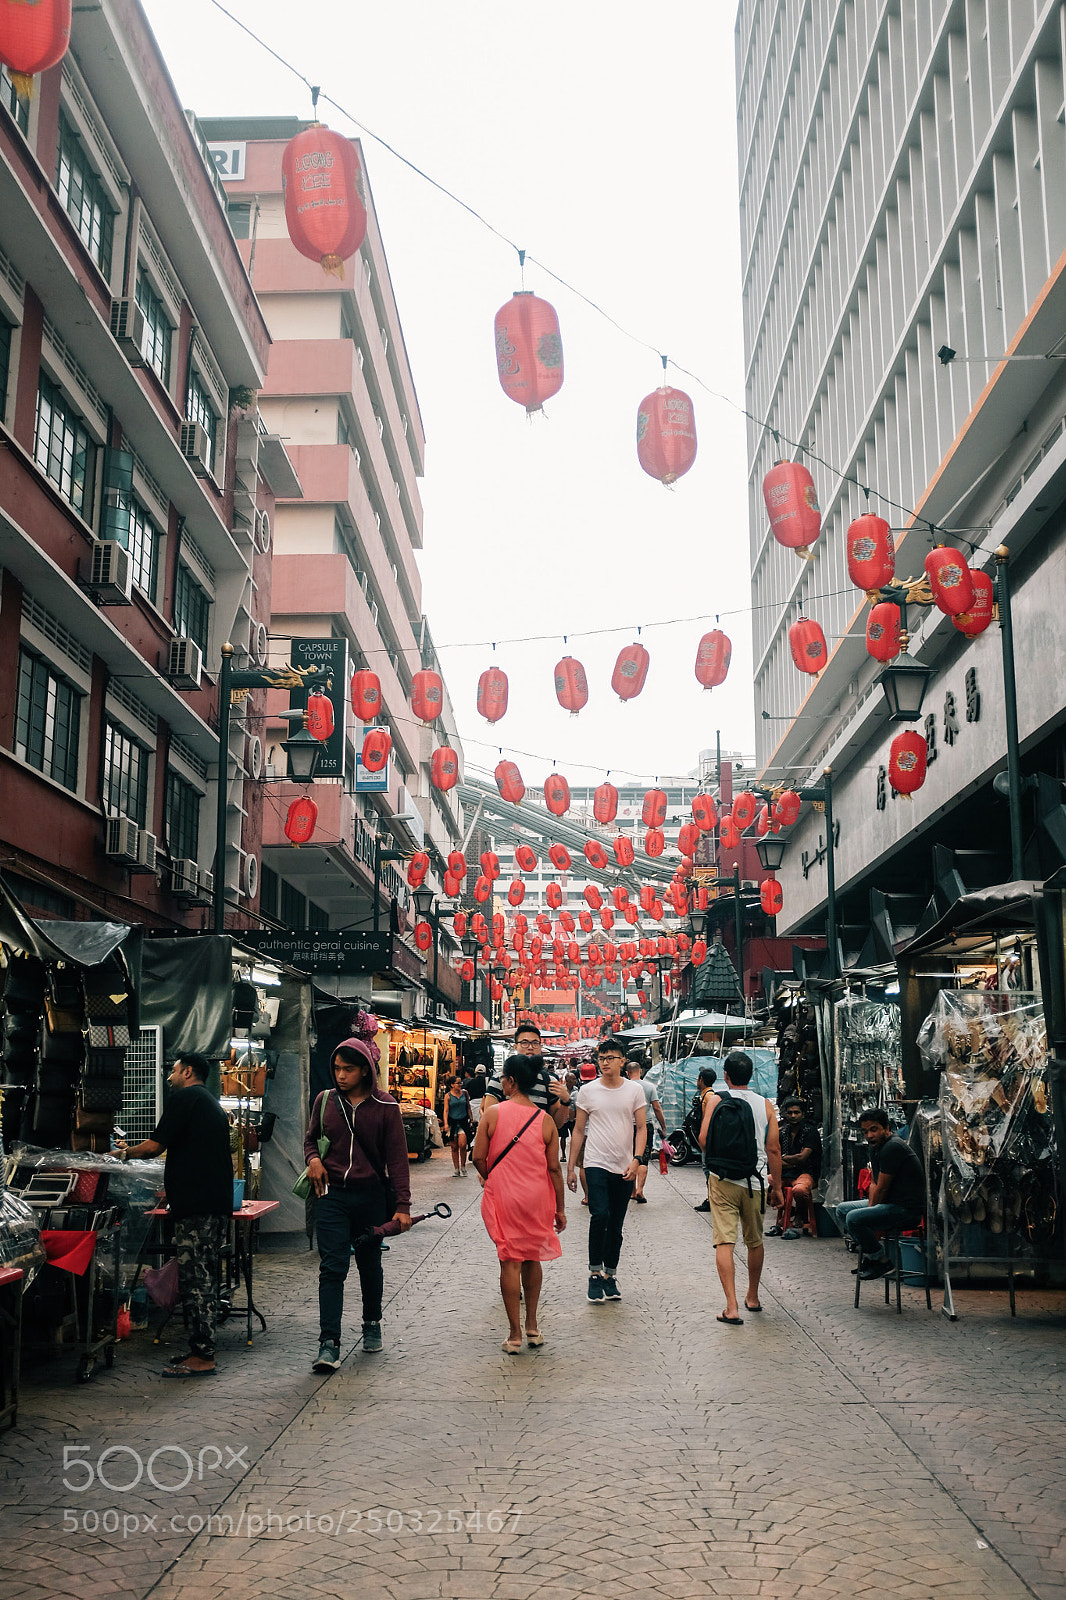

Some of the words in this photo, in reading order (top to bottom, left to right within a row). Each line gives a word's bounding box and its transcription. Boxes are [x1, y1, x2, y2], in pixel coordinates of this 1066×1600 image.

[294, 151, 335, 173] LOONG
[301, 172, 332, 191] KEE
[298, 643, 339, 652] CAPSULE
[303, 652, 333, 661] TOWN
[257, 939, 311, 950] authentic
[312, 940, 341, 952] gerai
[345, 940, 380, 950] cuisine
